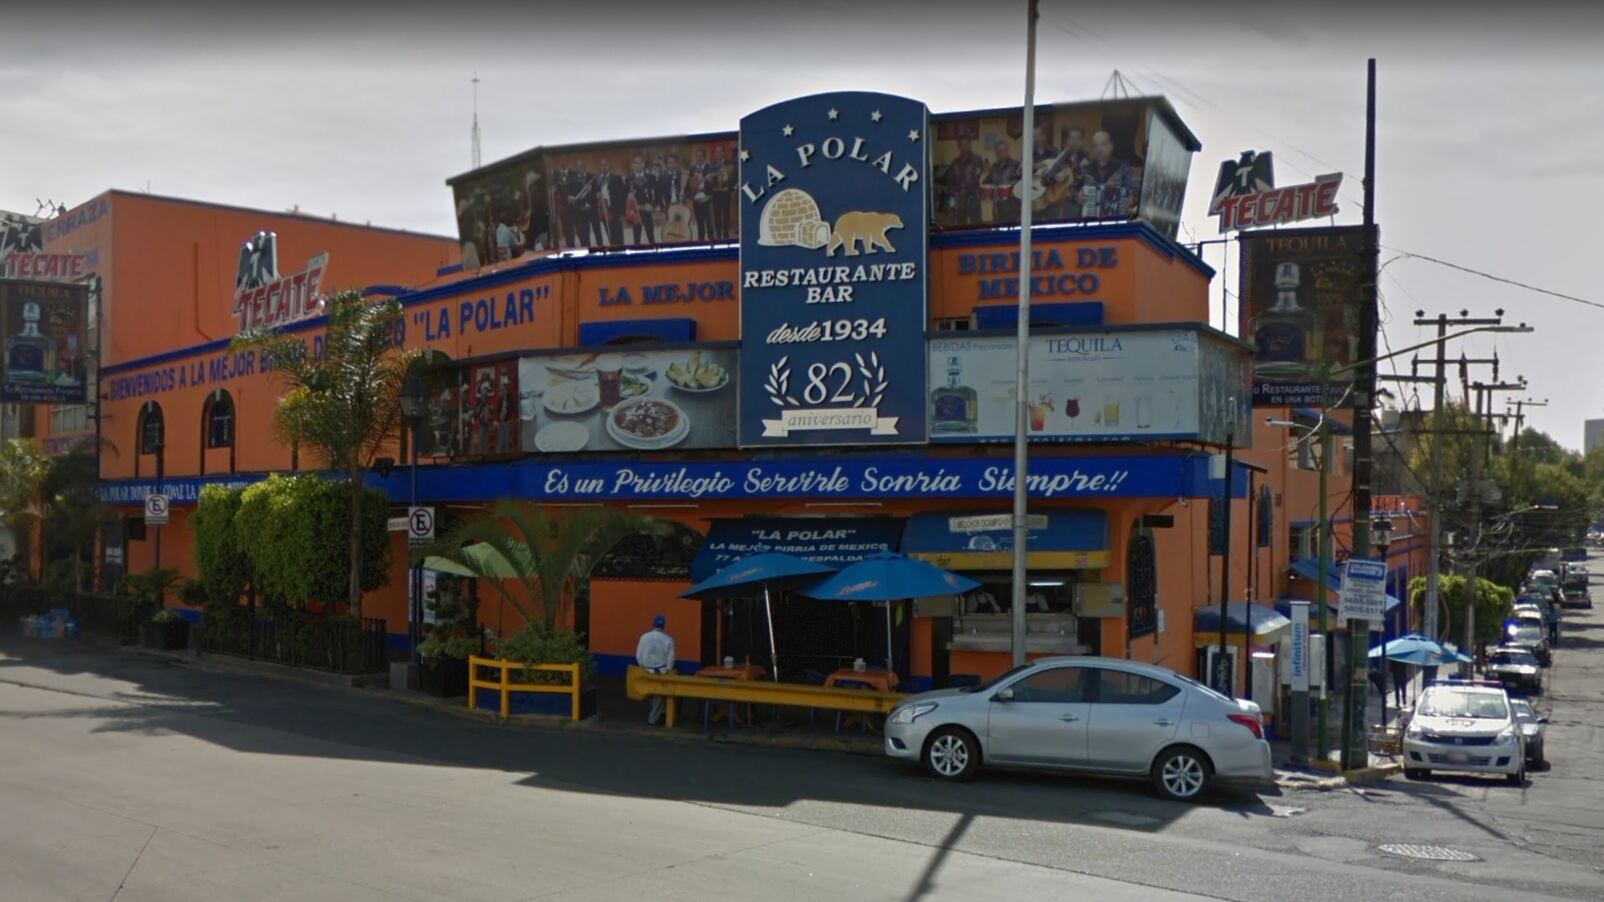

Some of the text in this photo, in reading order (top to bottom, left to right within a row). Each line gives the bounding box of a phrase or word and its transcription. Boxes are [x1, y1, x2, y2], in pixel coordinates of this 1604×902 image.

[742, 137, 919, 203] LA POLAR
[1216, 180, 1341, 230] TECATE
[6, 251, 85, 277] TECATE
[1077, 247, 1119, 269] DE
[743, 262, 916, 288] RESTAURANTE
[240, 266, 322, 331] TECATE
[598, 281, 735, 306] LA MEJOR
[806, 286, 853, 304] BAR
[111, 367, 175, 400] BIENVENIDOS
[178, 366, 187, 388] A
[190, 360, 204, 386] LA
[208, 351, 255, 382] MEJOR
[413, 307, 451, 342] "LA
[460, 285, 549, 336] POLAR"
[820, 318, 887, 342] 1934
[1046, 338, 1123, 355] TEQUILA
[804, 362, 855, 404] 82
[788, 411, 872, 427] aniversario
[544, 469, 568, 493] Es
[574, 478, 603, 493] un
[611, 468, 735, 497] Privilegio
[744, 467, 848, 492] Servirle
[752, 529, 857, 540] "LA POLAR"
[819, 542, 835, 551] DE
[838, 542, 888, 551] MEXICO
[1293, 622, 1302, 676] infinitum
